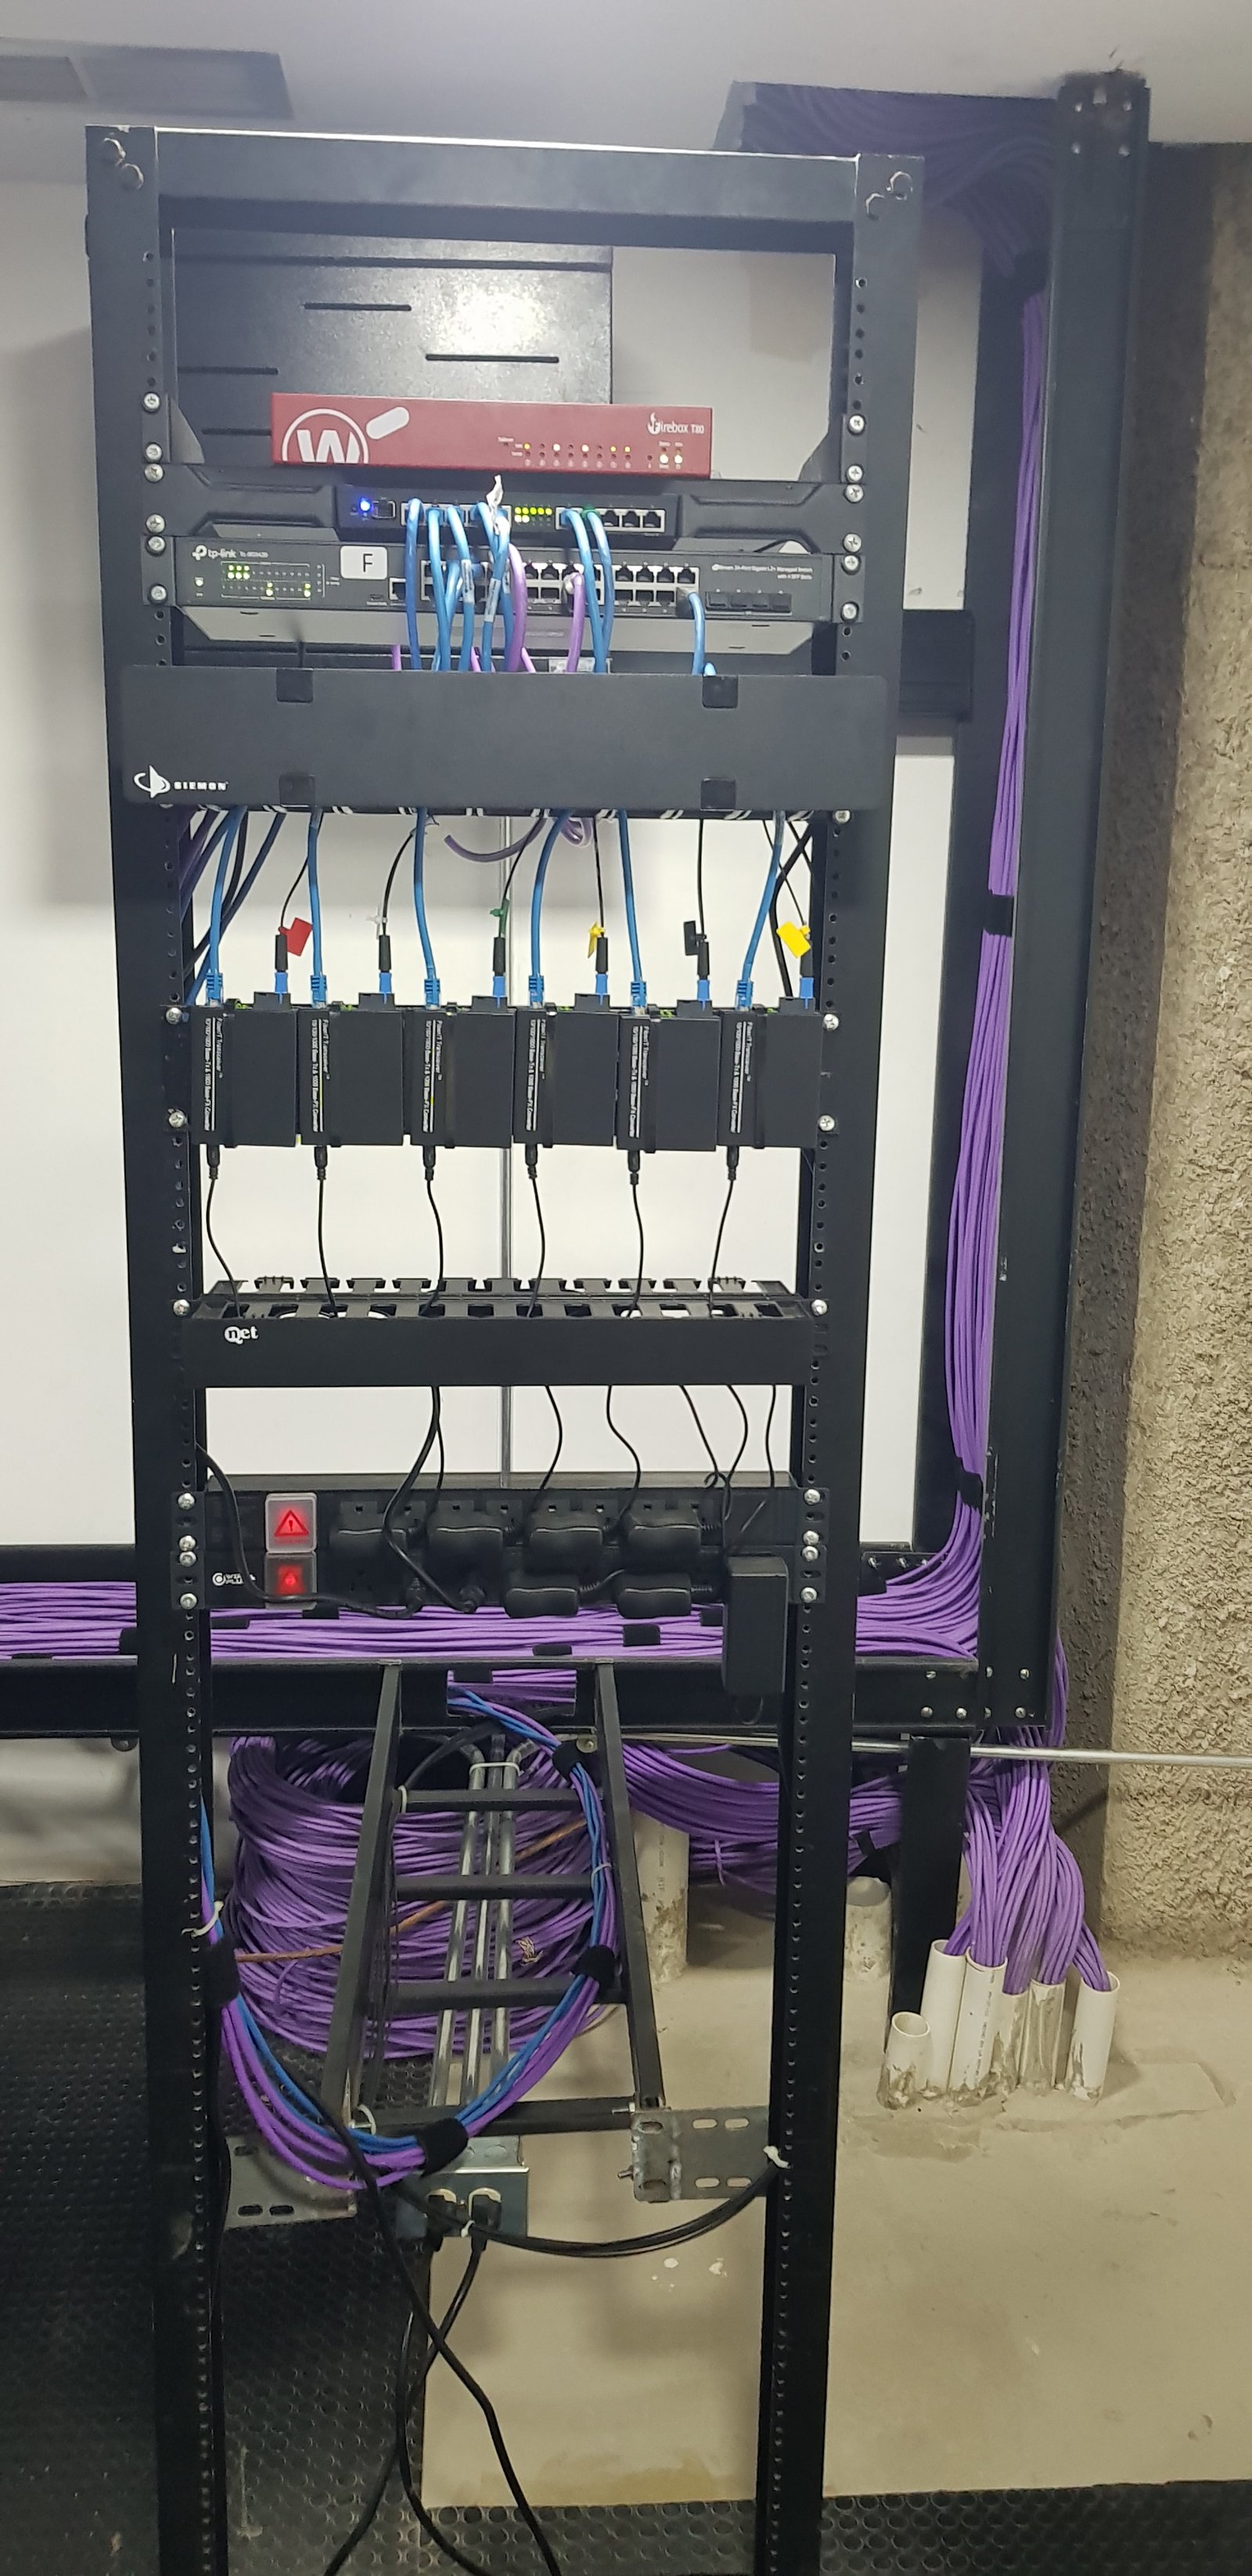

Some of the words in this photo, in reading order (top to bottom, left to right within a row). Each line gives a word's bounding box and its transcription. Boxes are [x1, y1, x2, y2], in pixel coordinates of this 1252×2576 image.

[648, 412, 688, 434] Firebox
[297, 430, 361, 463] W
[208, 549, 236, 559] tp-link
[363, 553, 372, 572] F
[174, 781, 227, 791] SIEMON
